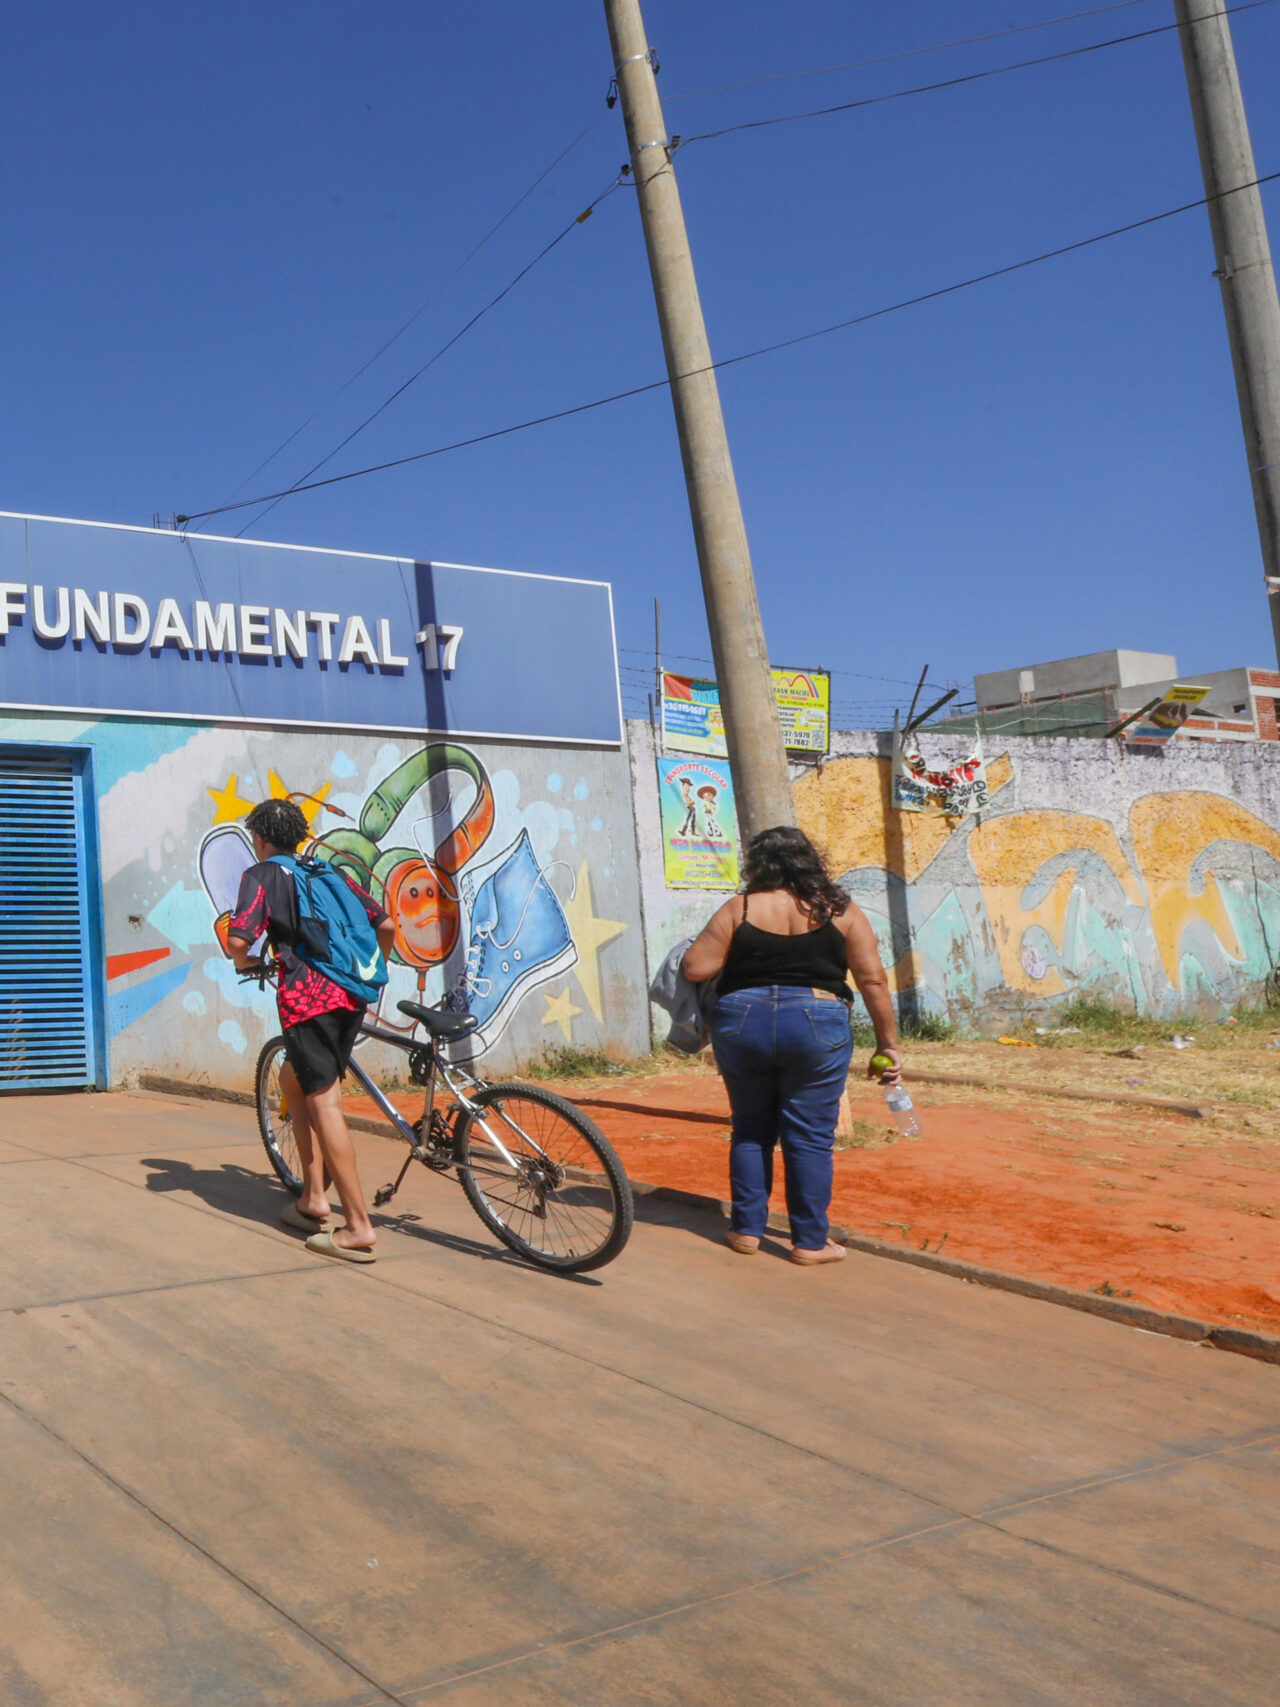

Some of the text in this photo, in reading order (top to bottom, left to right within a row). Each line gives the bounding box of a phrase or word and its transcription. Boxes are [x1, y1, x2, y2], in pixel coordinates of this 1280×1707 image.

[415, 623, 464, 671] 17
[664, 763, 728, 788] TRANSPORTE ESCOLAR
